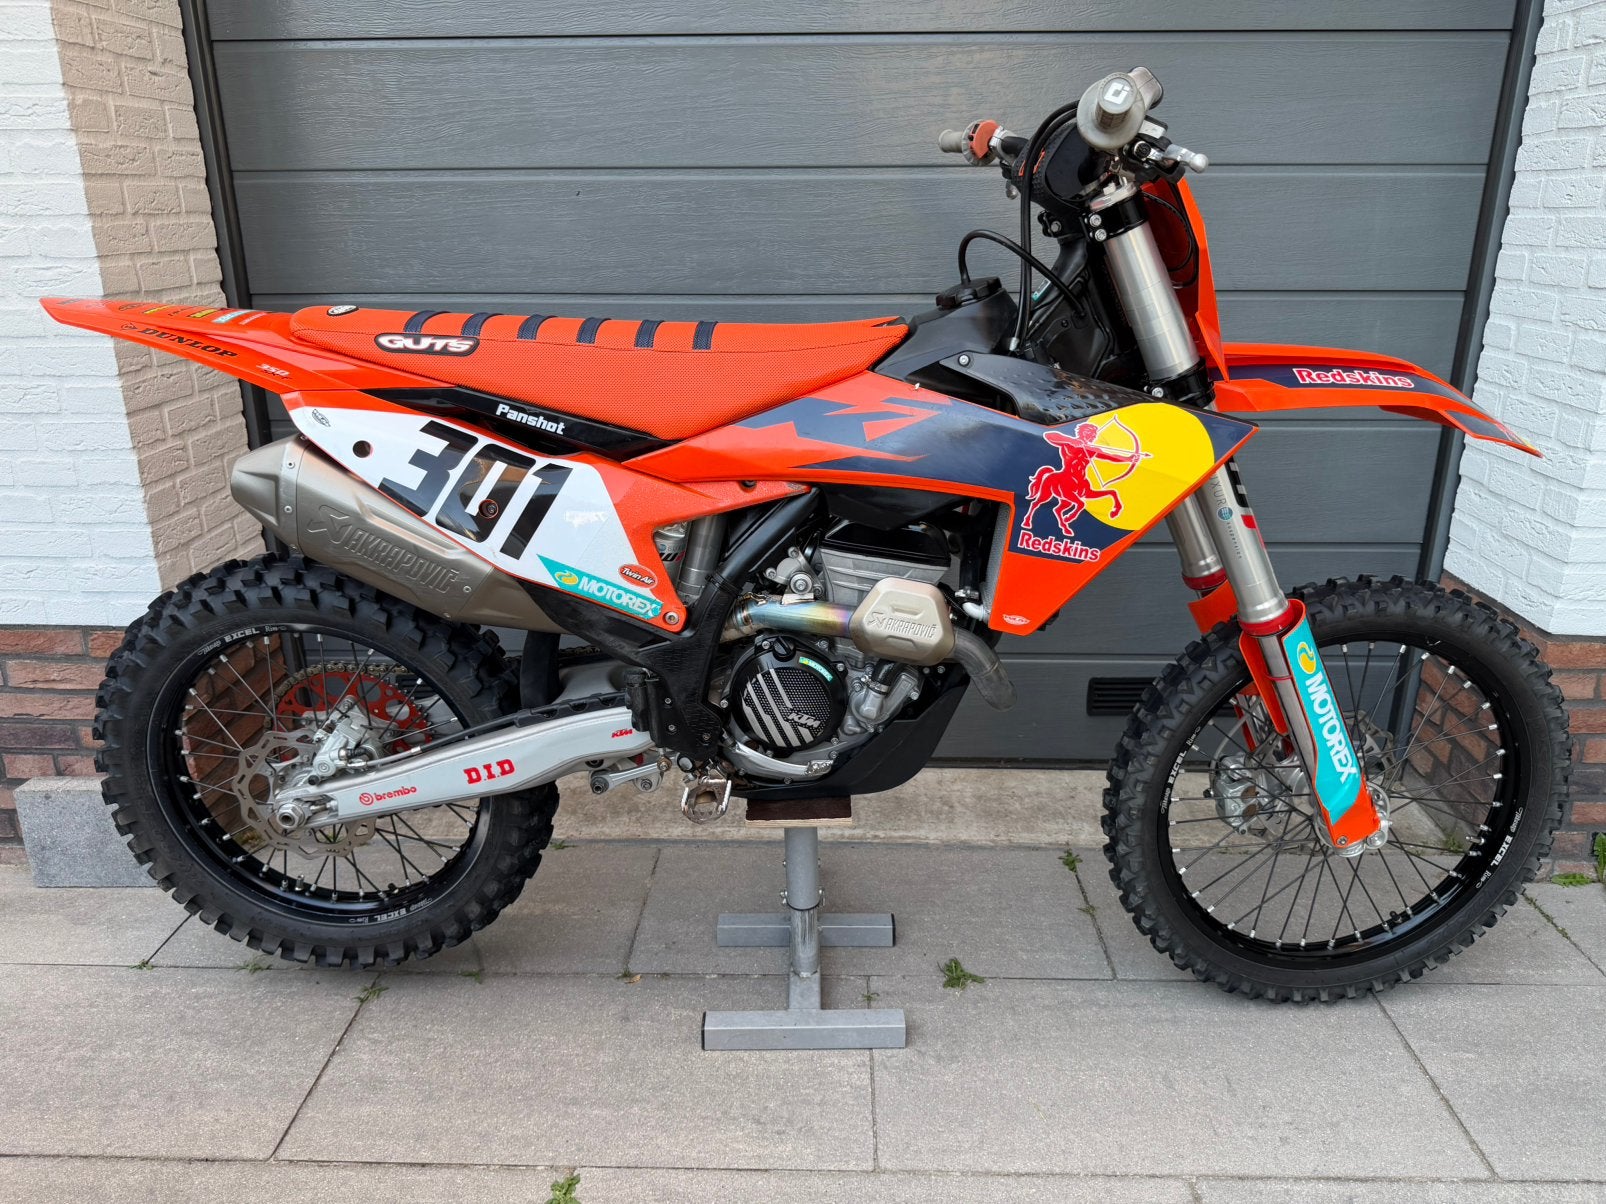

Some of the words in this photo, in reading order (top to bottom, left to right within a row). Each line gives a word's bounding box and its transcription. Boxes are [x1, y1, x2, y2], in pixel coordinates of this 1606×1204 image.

[138, 327, 238, 358] DUNLOP
[377, 334, 475, 352] GUTS
[1292, 367, 1415, 389] Redskins
[495, 403, 566, 435] Panshot
[377, 420, 574, 561] 301
[1018, 530, 1101, 562] Redskins
[621, 567, 642, 582] Twin
[640, 576, 656, 585] Air
[578, 575, 661, 618] MOTOREX
[223, 627, 260, 643] EXCEL
[788, 712, 821, 728] KTM
[1305, 670, 1359, 785] MOTOREX
[611, 728, 633, 739] KTM
[463, 758, 516, 784] D.I.D
[1167, 750, 1188, 784] EXCEL
[373, 785, 418, 803] brembo
[1490, 834, 1514, 867] EXCEL
[373, 907, 407, 922] EXCEL
